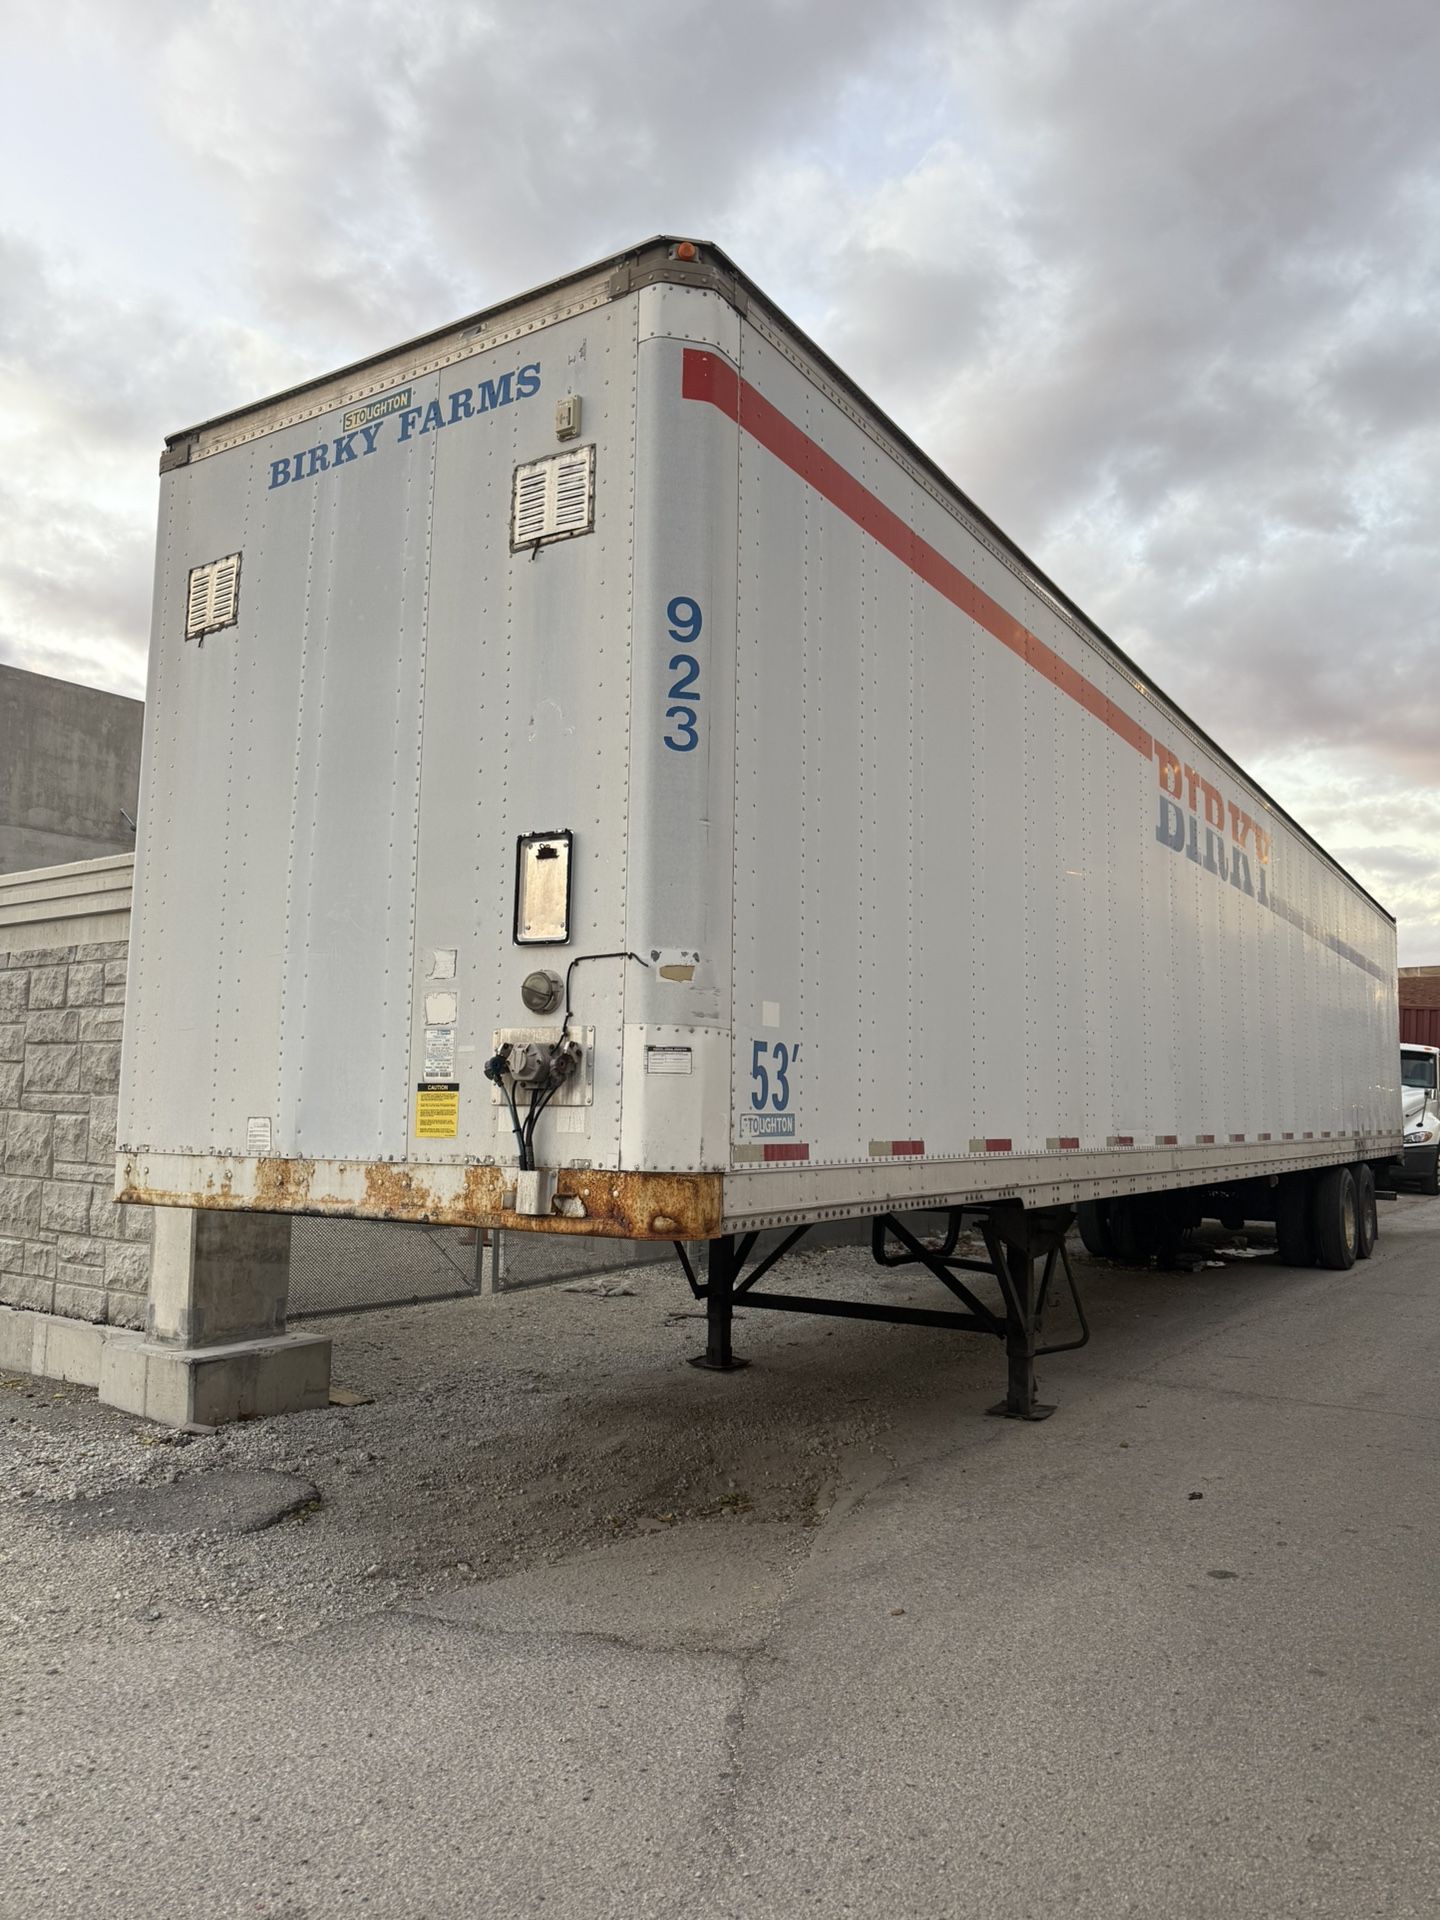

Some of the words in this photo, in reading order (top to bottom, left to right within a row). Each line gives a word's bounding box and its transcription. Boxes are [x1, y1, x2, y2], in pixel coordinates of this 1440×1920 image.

[268, 422, 383, 490] BIRKY
[398, 362, 541, 443] FARMS
[345, 392, 408, 428] STOUGHTON
[663, 596, 702, 752] 923
